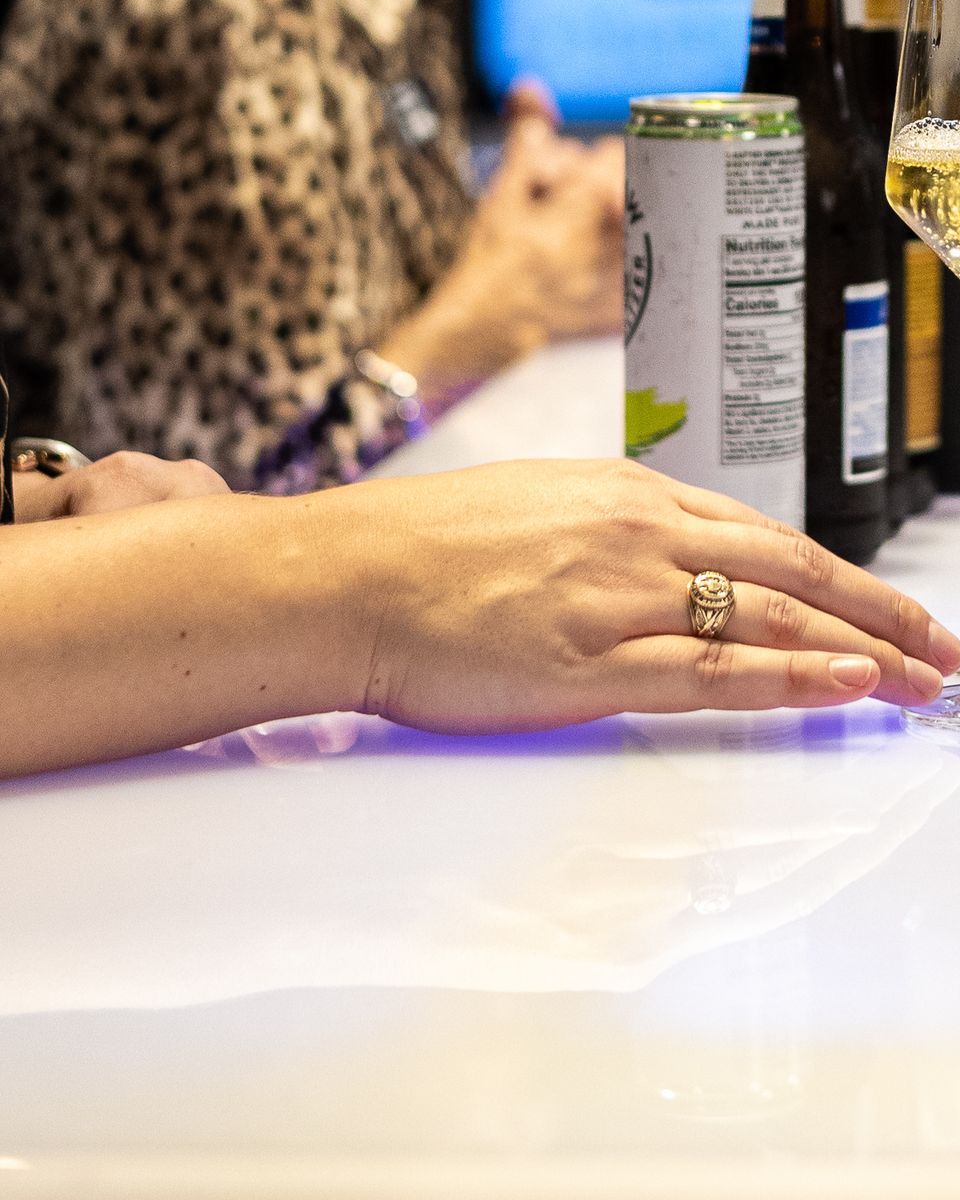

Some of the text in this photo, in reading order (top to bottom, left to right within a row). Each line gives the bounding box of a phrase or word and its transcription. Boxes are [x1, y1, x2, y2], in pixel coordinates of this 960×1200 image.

[743, 217, 779, 229] MADE
[725, 237, 786, 253] Nutrition
[725, 296, 779, 312] Calories
